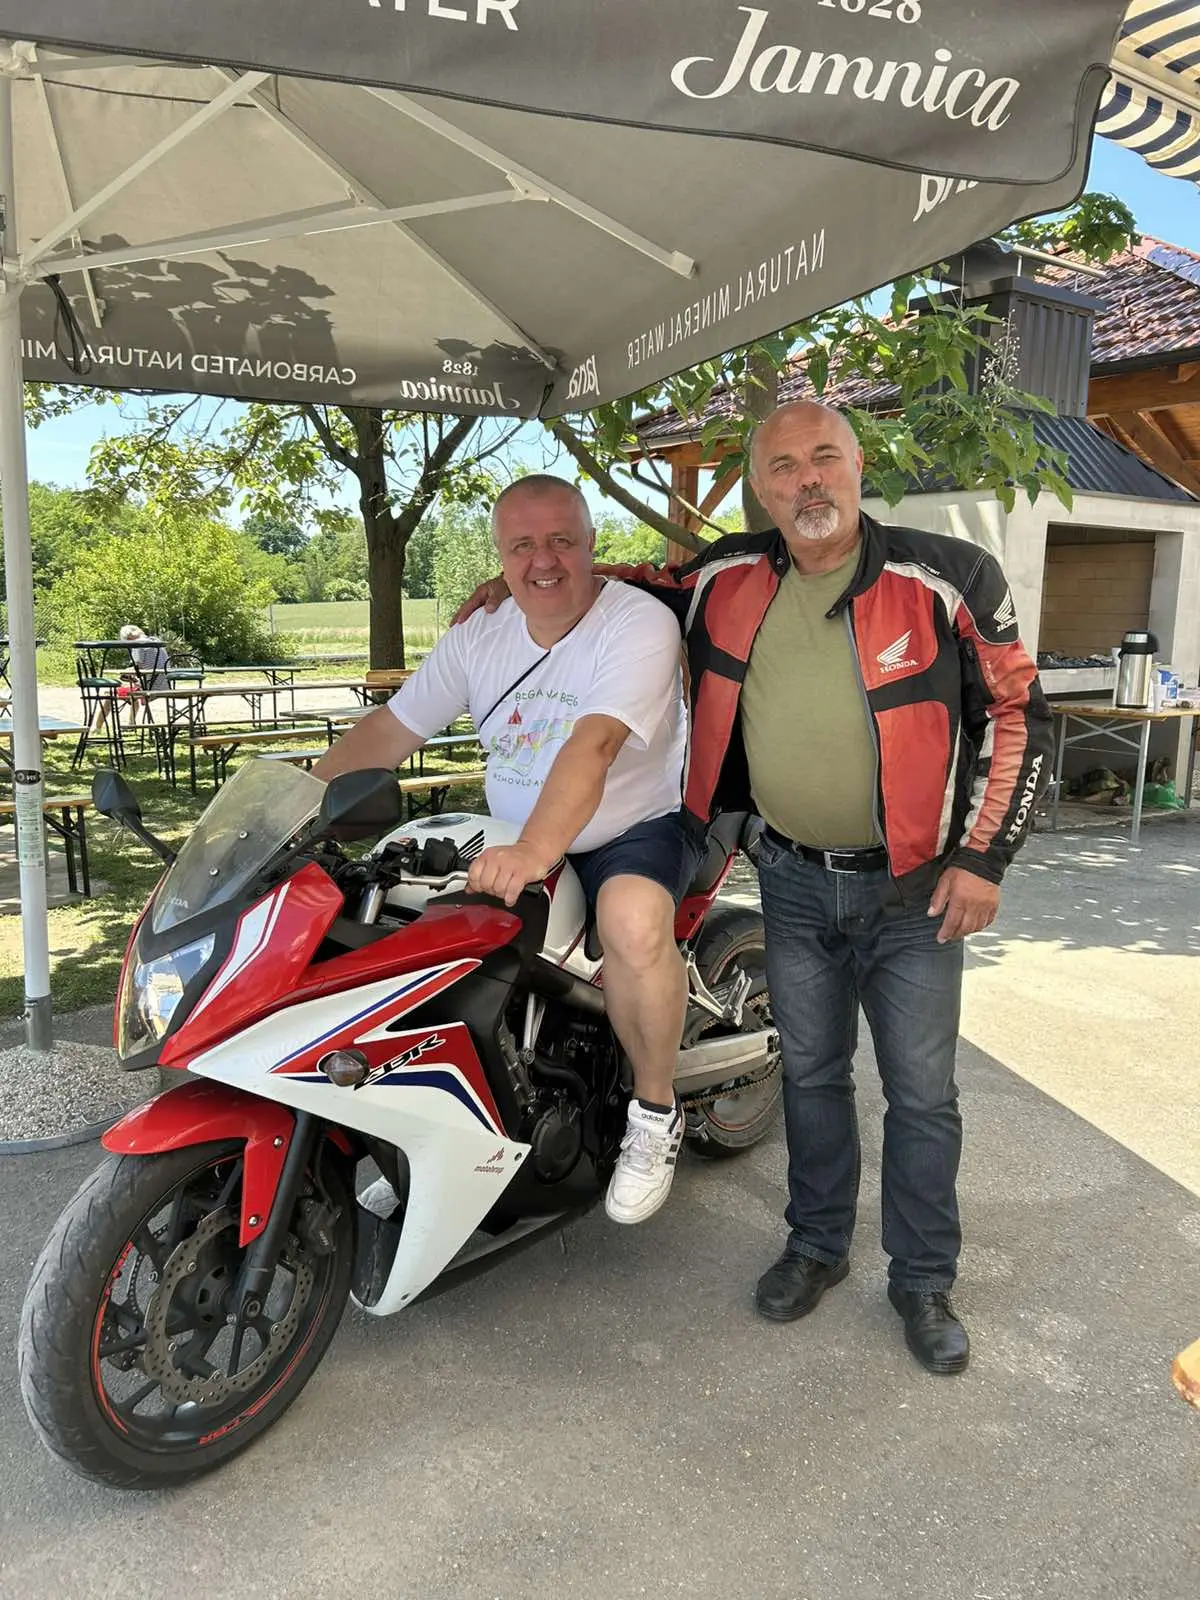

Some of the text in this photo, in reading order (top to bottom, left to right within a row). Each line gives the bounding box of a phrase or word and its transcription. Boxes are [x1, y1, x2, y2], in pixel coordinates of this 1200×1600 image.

[670, 6, 1021, 131] Jamnica
[880, 659, 918, 674] HONDA
[1004, 753, 1044, 845] HONDA
[353, 1033, 447, 1091] CBR
[641, 1113, 665, 1123] adidas
